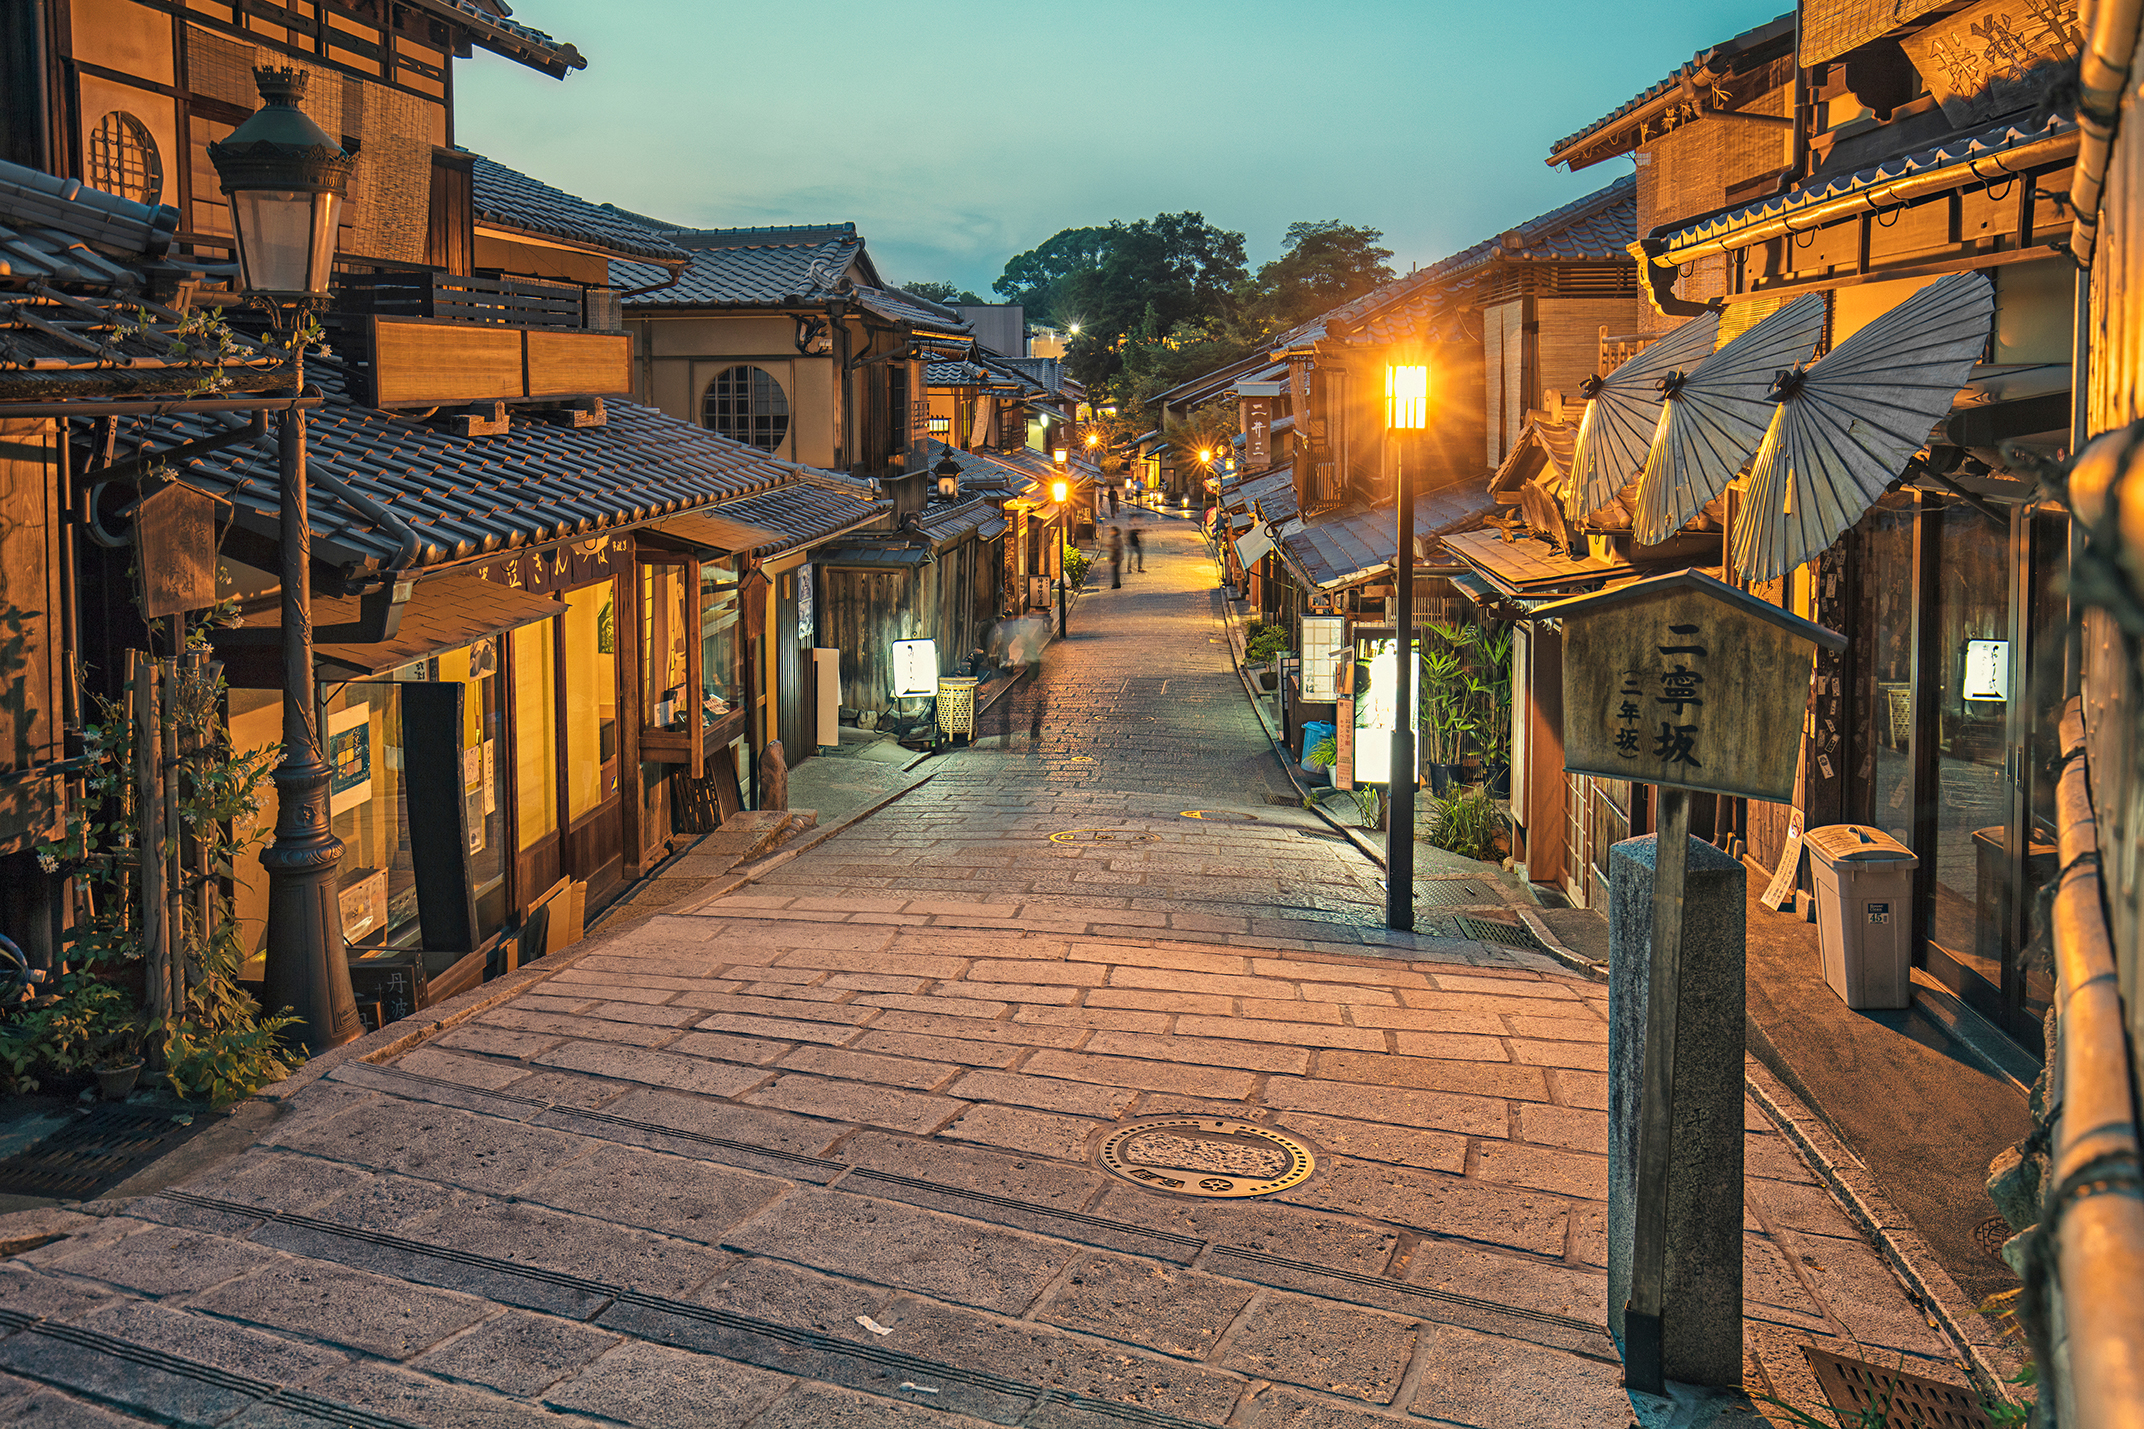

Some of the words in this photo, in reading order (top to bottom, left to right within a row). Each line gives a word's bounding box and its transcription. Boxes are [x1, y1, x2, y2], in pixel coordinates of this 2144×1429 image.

[1250, 403, 1268, 456] 二井三
[1613, 669, 1644, 760] (二年坂)
[1652, 623, 1708, 768] 二寧坂
[1870, 913, 1883, 922] 45
[387, 972, 408, 1019] 丹波
